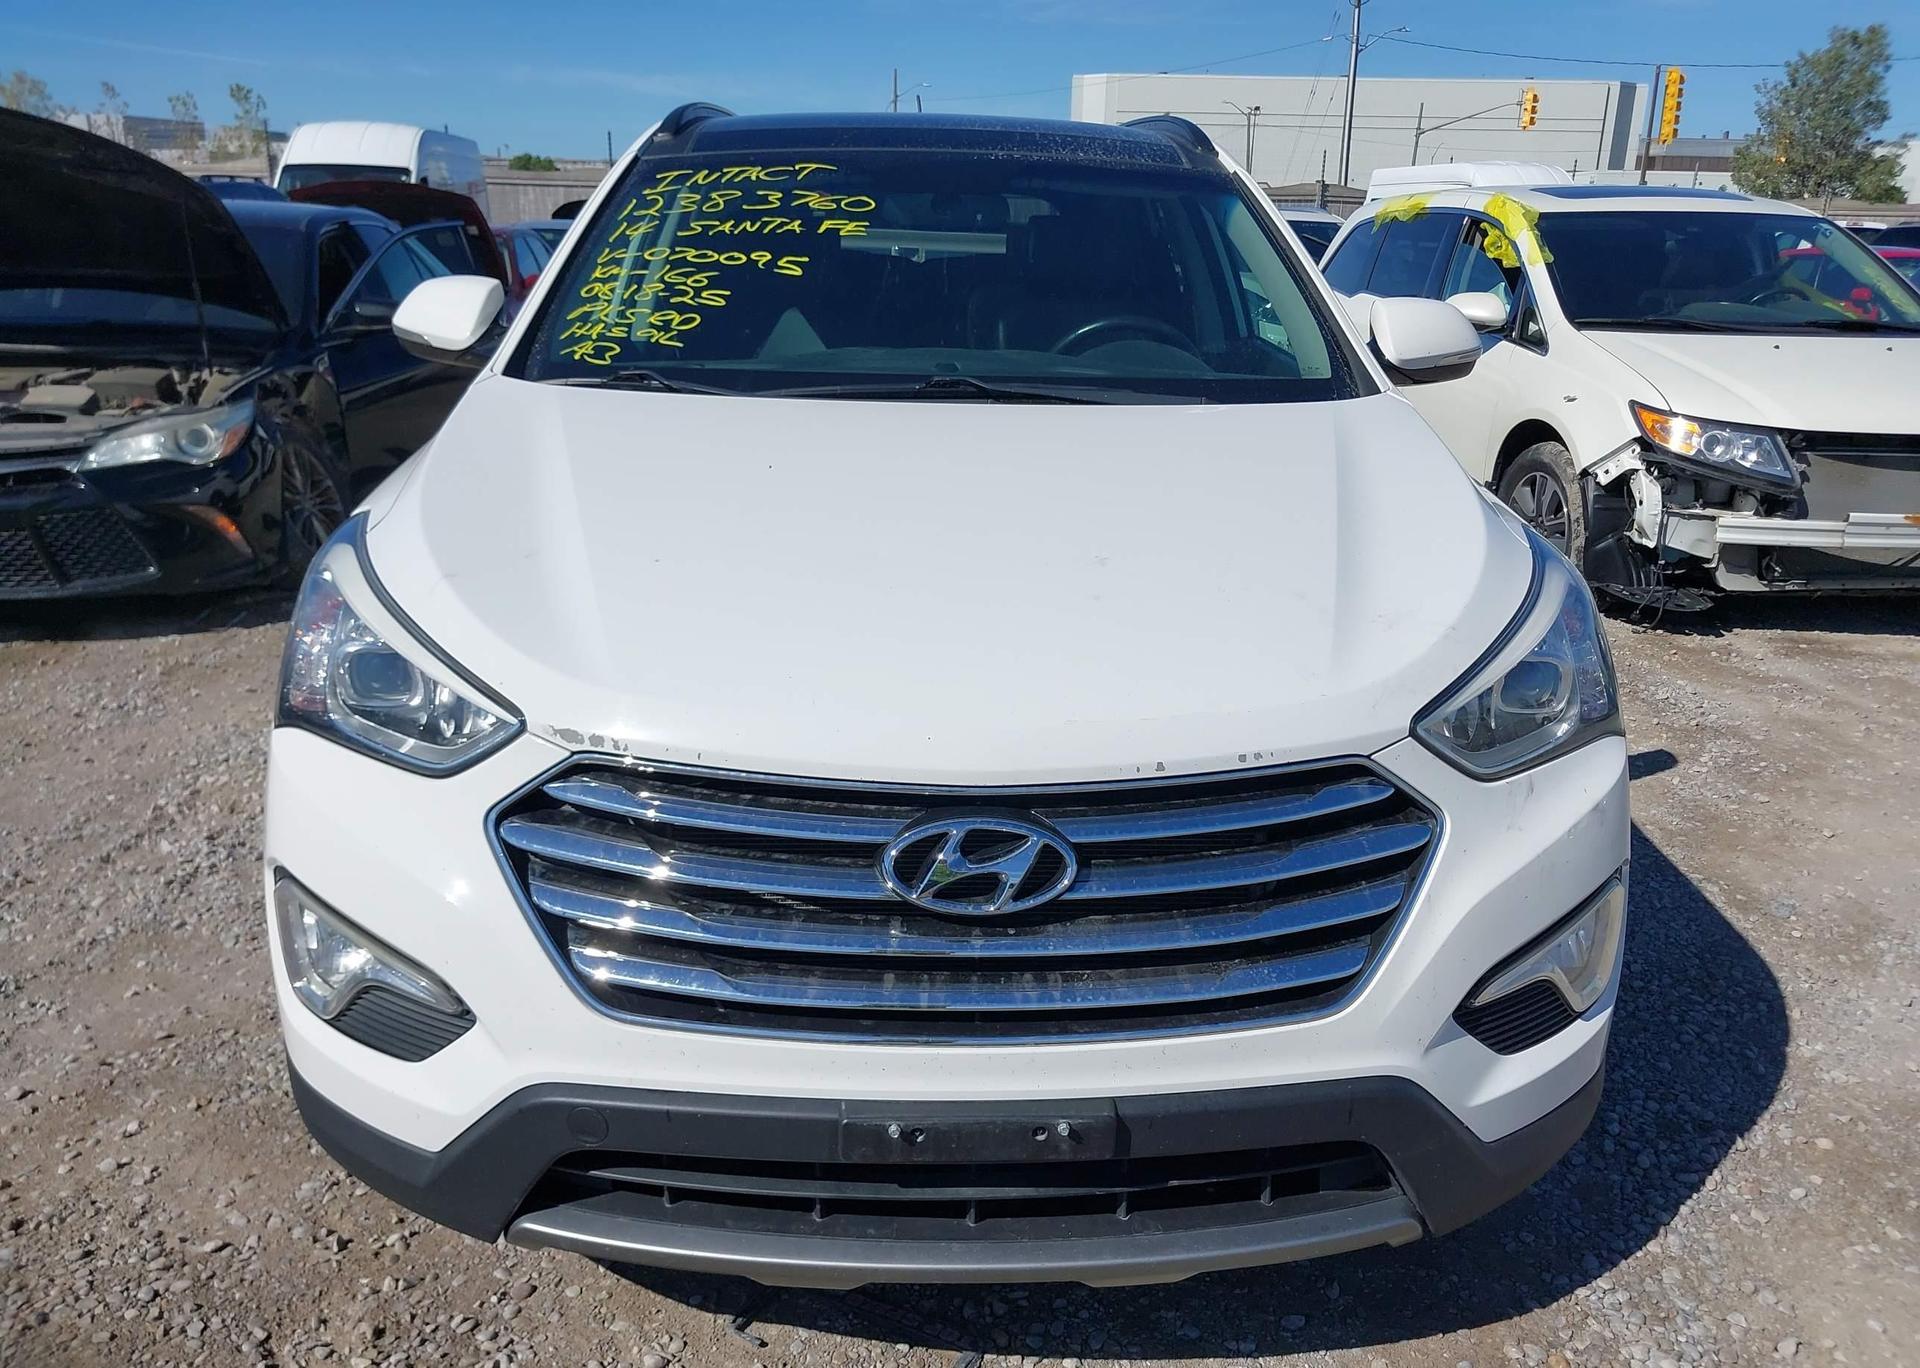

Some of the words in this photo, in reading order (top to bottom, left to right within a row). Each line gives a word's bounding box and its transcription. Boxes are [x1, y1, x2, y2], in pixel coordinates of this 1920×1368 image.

[643, 163, 838, 195] INTACT
[676, 217, 807, 238] SANTA
[816, 219, 871, 237] FE
